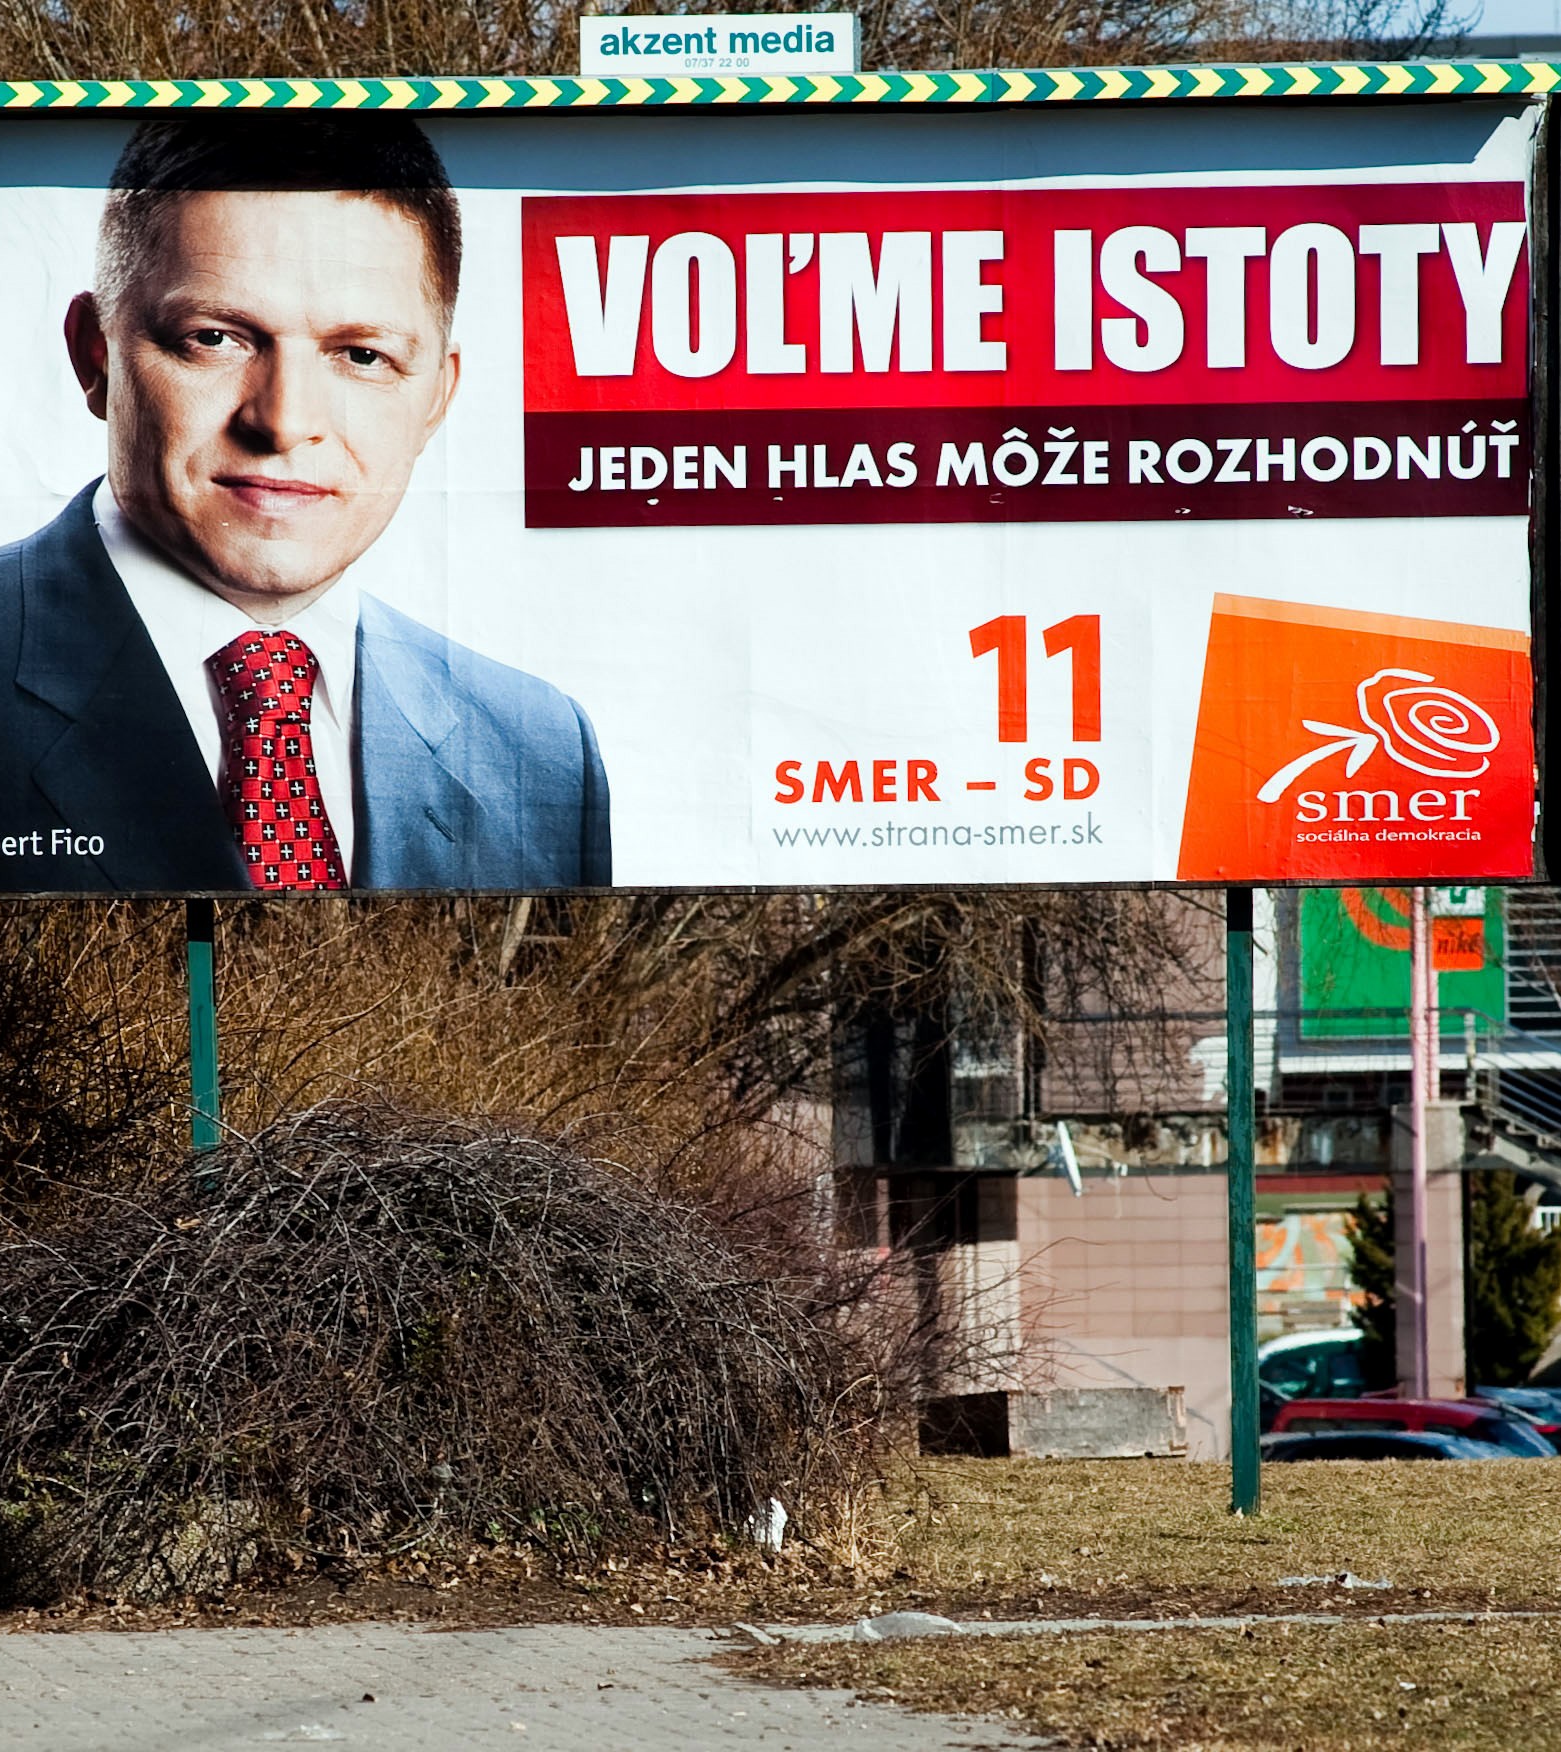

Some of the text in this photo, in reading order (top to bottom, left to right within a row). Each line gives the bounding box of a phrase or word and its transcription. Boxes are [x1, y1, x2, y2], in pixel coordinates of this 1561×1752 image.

[599, 24, 835, 57] akzent media
[719, 57, 733, 68] 22
[736, 57, 750, 68] 00
[554, 222, 1527, 378] VOĽME ISTOTY
[567, 419, 1520, 492] JEDEN HLAS MÔŽE ROZHODNÚŤ
[968, 614, 1102, 743] 11
[774, 759, 941, 805] SMER
[1023, 757, 1100, 802] SD
[1296, 789, 1481, 823] smer
[51, 827, 105, 856] Fico
[772, 811, 1104, 848] www.strana-smer.sk
[1296, 828, 1481, 843] sociálna demokracia
